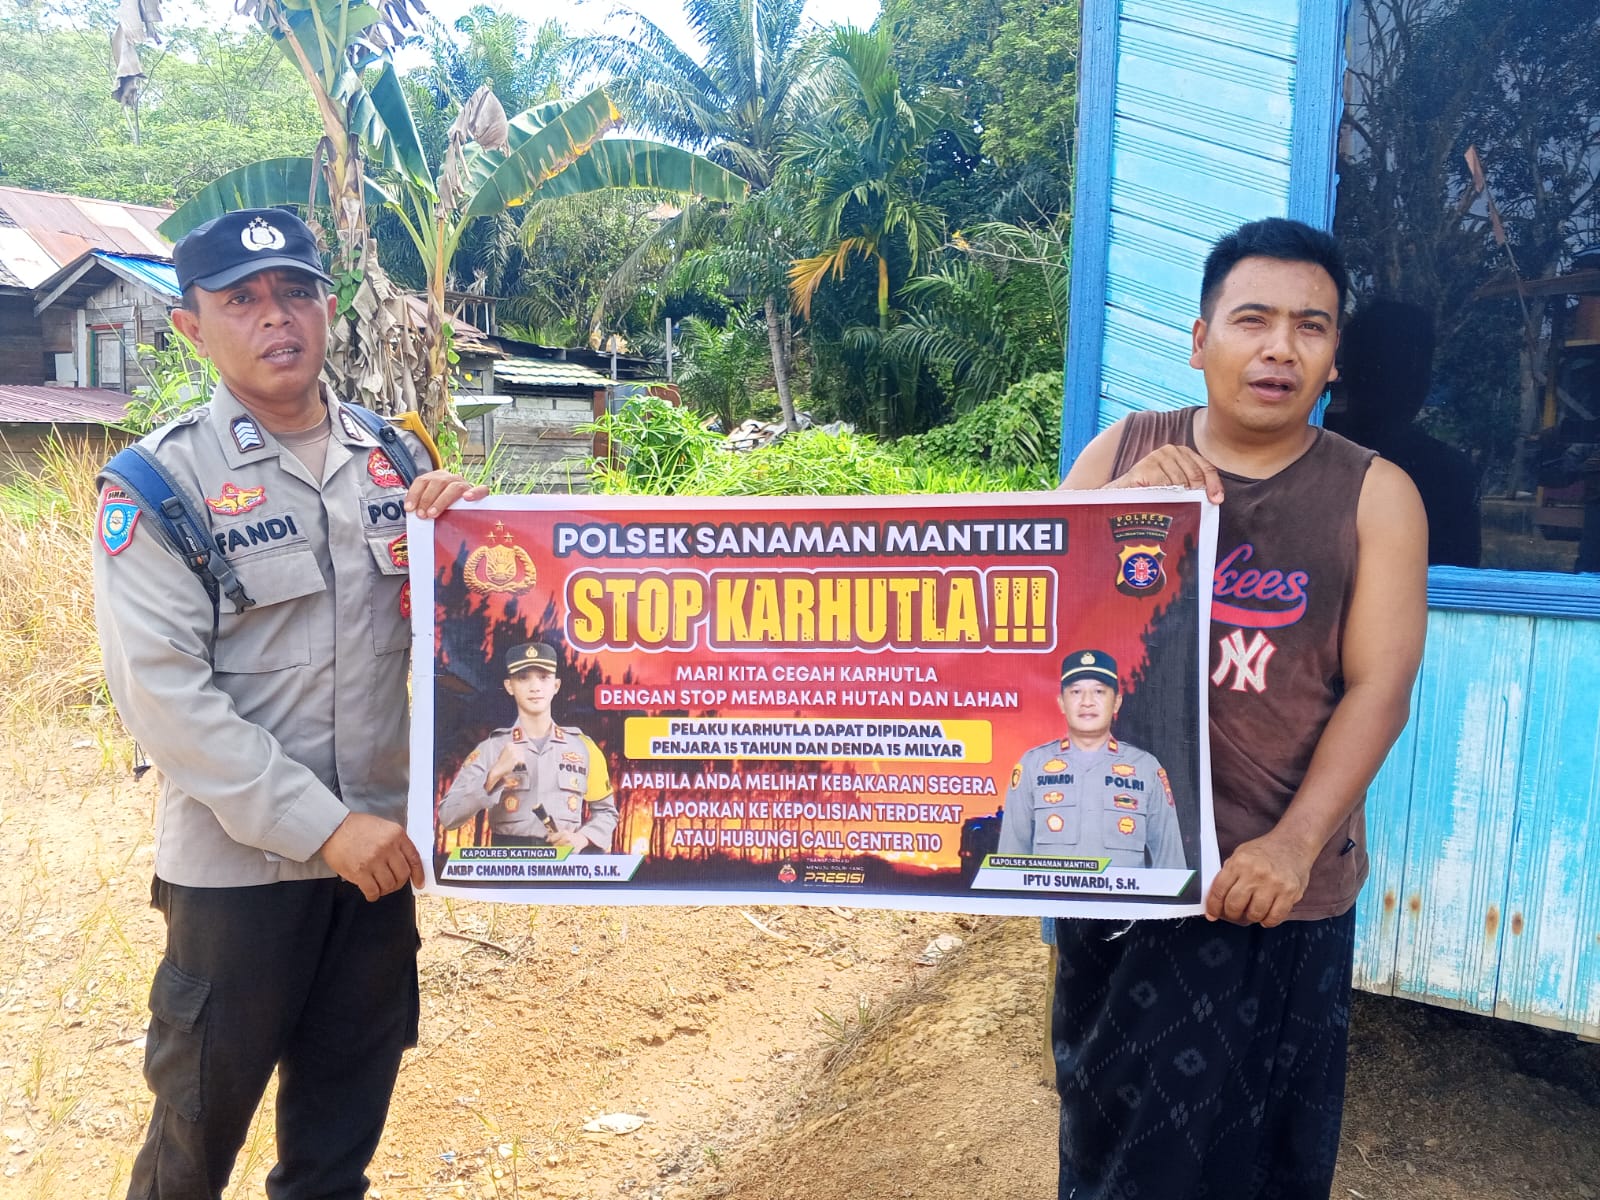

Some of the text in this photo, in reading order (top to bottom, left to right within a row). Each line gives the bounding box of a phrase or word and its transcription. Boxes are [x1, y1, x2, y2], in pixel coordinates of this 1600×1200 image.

[1116, 514, 1164, 522] POLRES
[214, 515, 298, 556] FANDI
[559, 523, 1063, 553] POLSEK SANAMAN MANTIKEI
[573, 577, 1048, 644] STOP KARHUTLA !!!
[676, 666, 938, 682] MARI KITA CEGAH KARHUTLA
[600, 689, 1018, 708] DENGAN STOP MEMBAKAR HUTAN DAN LAHAN
[671, 722, 942, 738] PELAKU KARHUTLA DAPAT DIPIDANA
[652, 741, 962, 757] PENJARA 15 TAHUN DAN DENDA 15 MILYAR
[621, 773, 691, 789] APABILA
[694, 774, 743, 790] ANDA
[745, 774, 817, 790] MELIHAT
[822, 775, 924, 793] KEBAKARAN
[928, 776, 996, 794] SEGERA
[1105, 776, 1144, 791] POLRI
[654, 801, 962, 822] LAPORKAN KE KEPOLISIAN TERDEKAT
[673, 830, 941, 851] ATAU HUBUNGI CALL CENTER 110
[462, 849, 556, 857] KAPOLRES KATINGAN
[447, 865, 620, 878] AKBP CHANDRA ISMAWANTO, S.I.K.
[990, 858, 1098, 869] KAPOLSEK SANAMAN MANTIKEI
[804, 872, 865, 883] PRESISI
[1023, 874, 1140, 891] IPTU SUWARDI, S.H.
